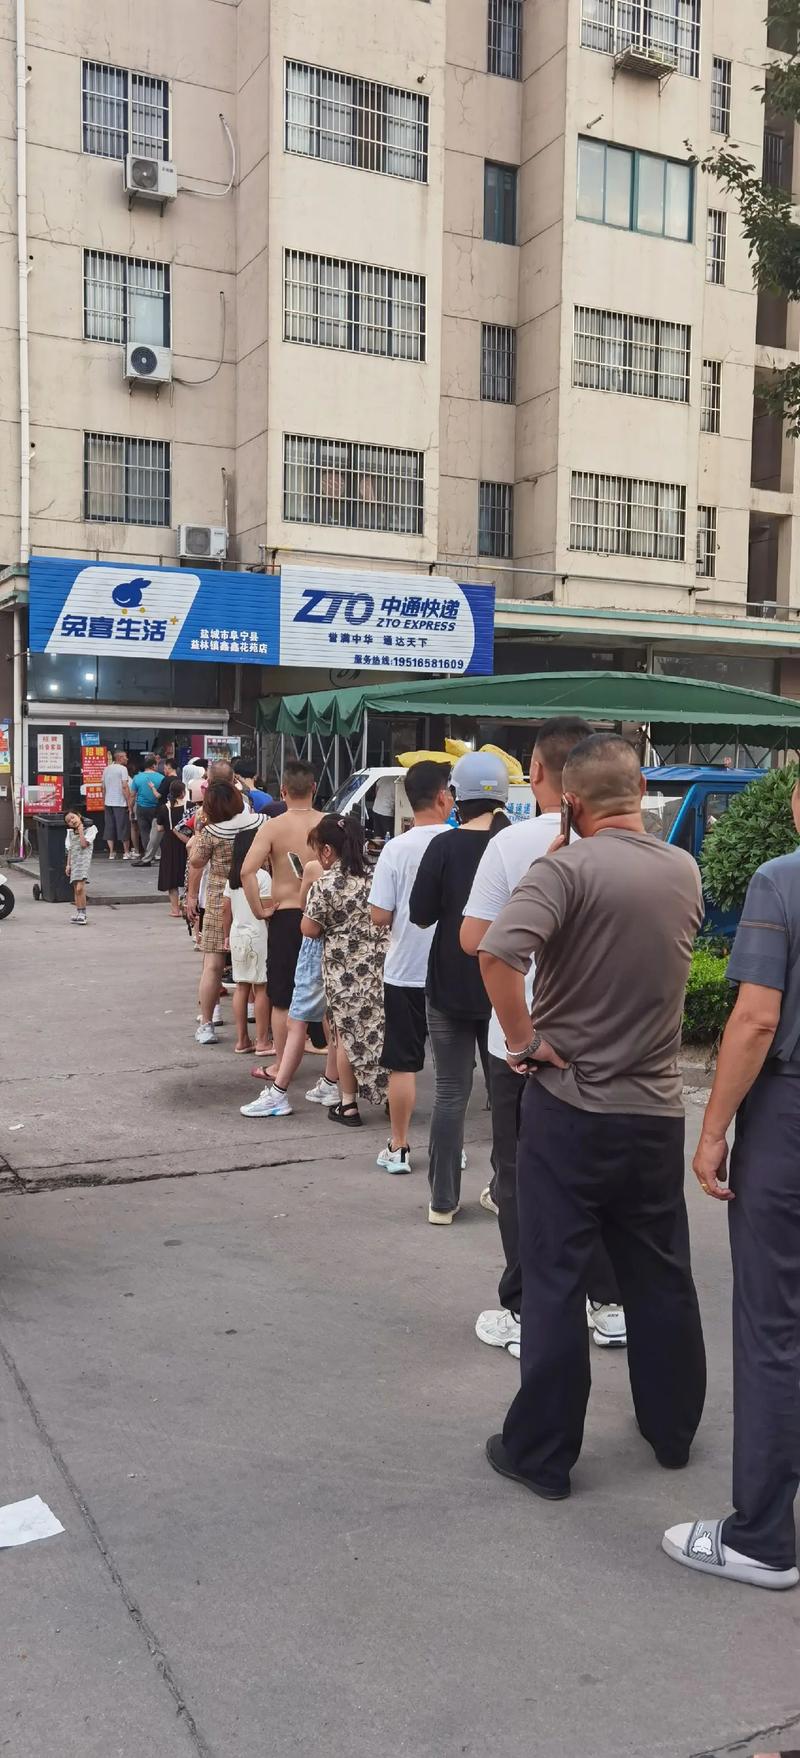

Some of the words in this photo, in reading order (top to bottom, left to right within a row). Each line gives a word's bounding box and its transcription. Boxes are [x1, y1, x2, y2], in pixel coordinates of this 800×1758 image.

[293, 589, 375, 625] ZTO
[381, 596, 460, 619] 中通快递
[376, 618, 401, 628] ZTO
[404, 620, 456, 631] EXPRESS
[200, 629, 259, 641] 盐城市阜宁县
[328, 632, 374, 645] 誉满中华
[384, 635, 428, 648] 通达天下
[191, 640, 268, 653] 益林镇鑫鑫花苑店
